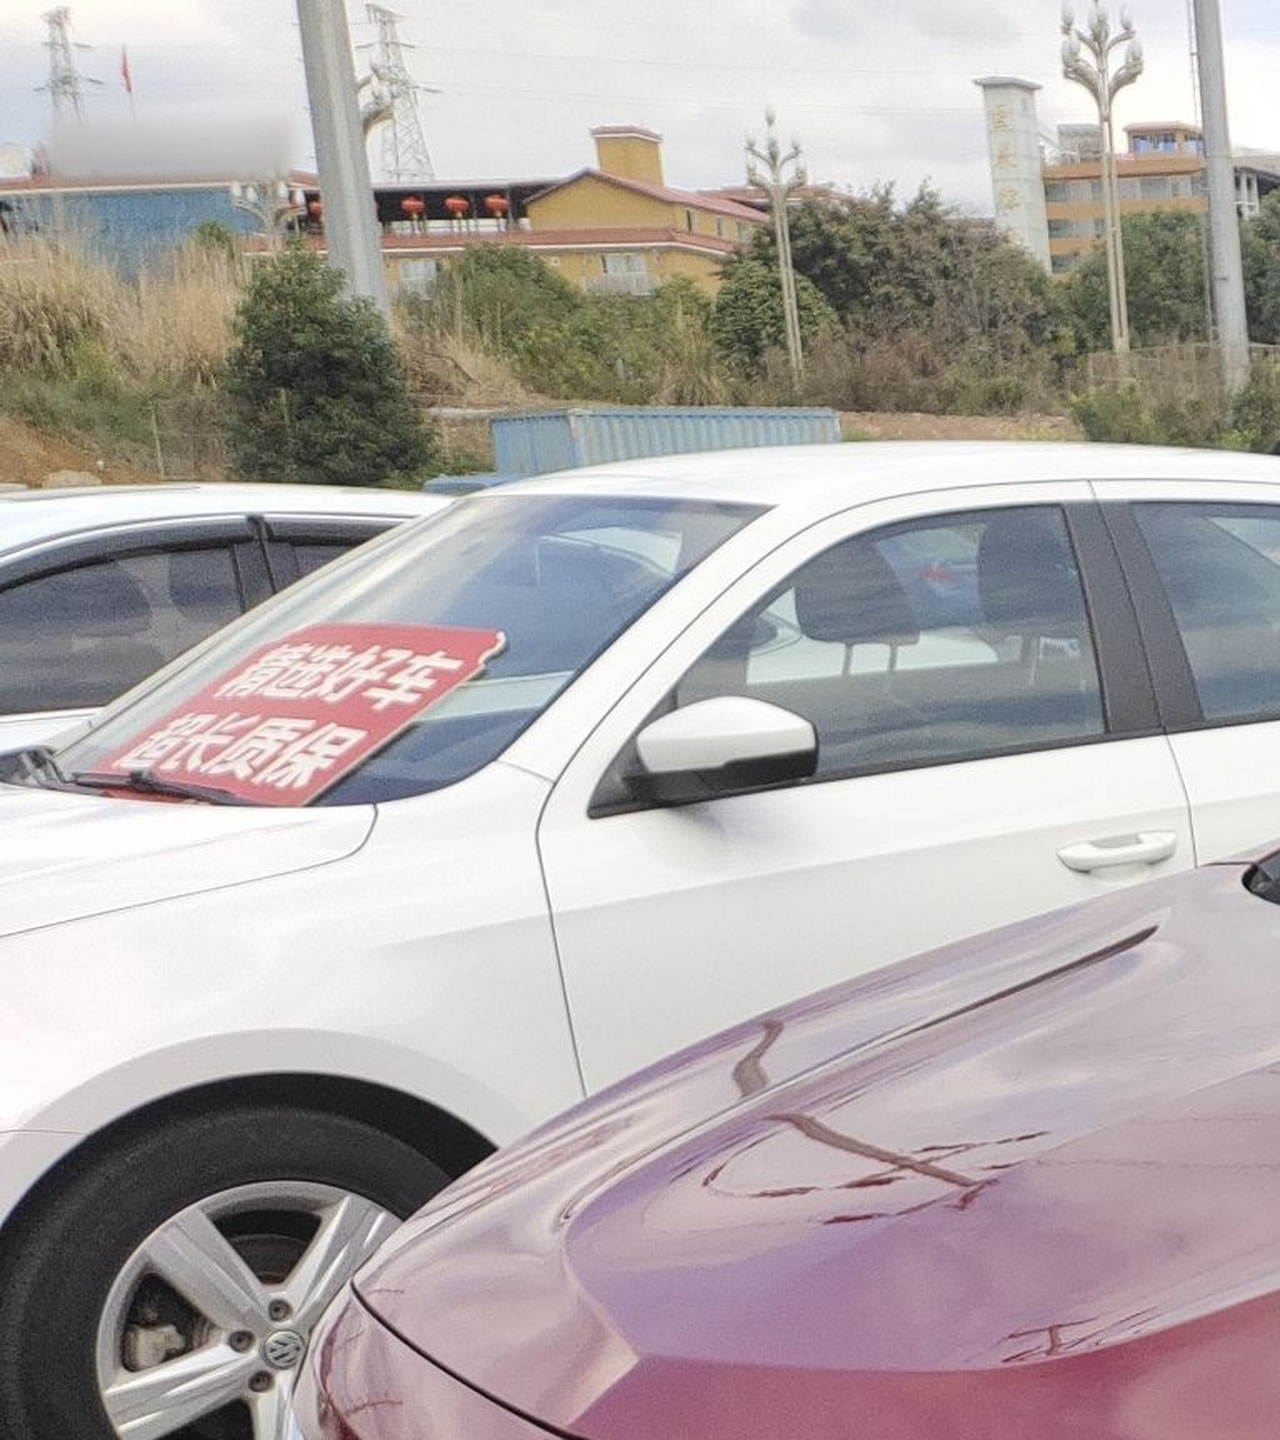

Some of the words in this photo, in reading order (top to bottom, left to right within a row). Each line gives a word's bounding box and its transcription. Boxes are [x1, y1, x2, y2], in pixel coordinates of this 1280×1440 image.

[213, 642, 465, 712] 精选好车
[111, 711, 368, 790] 超长质保
